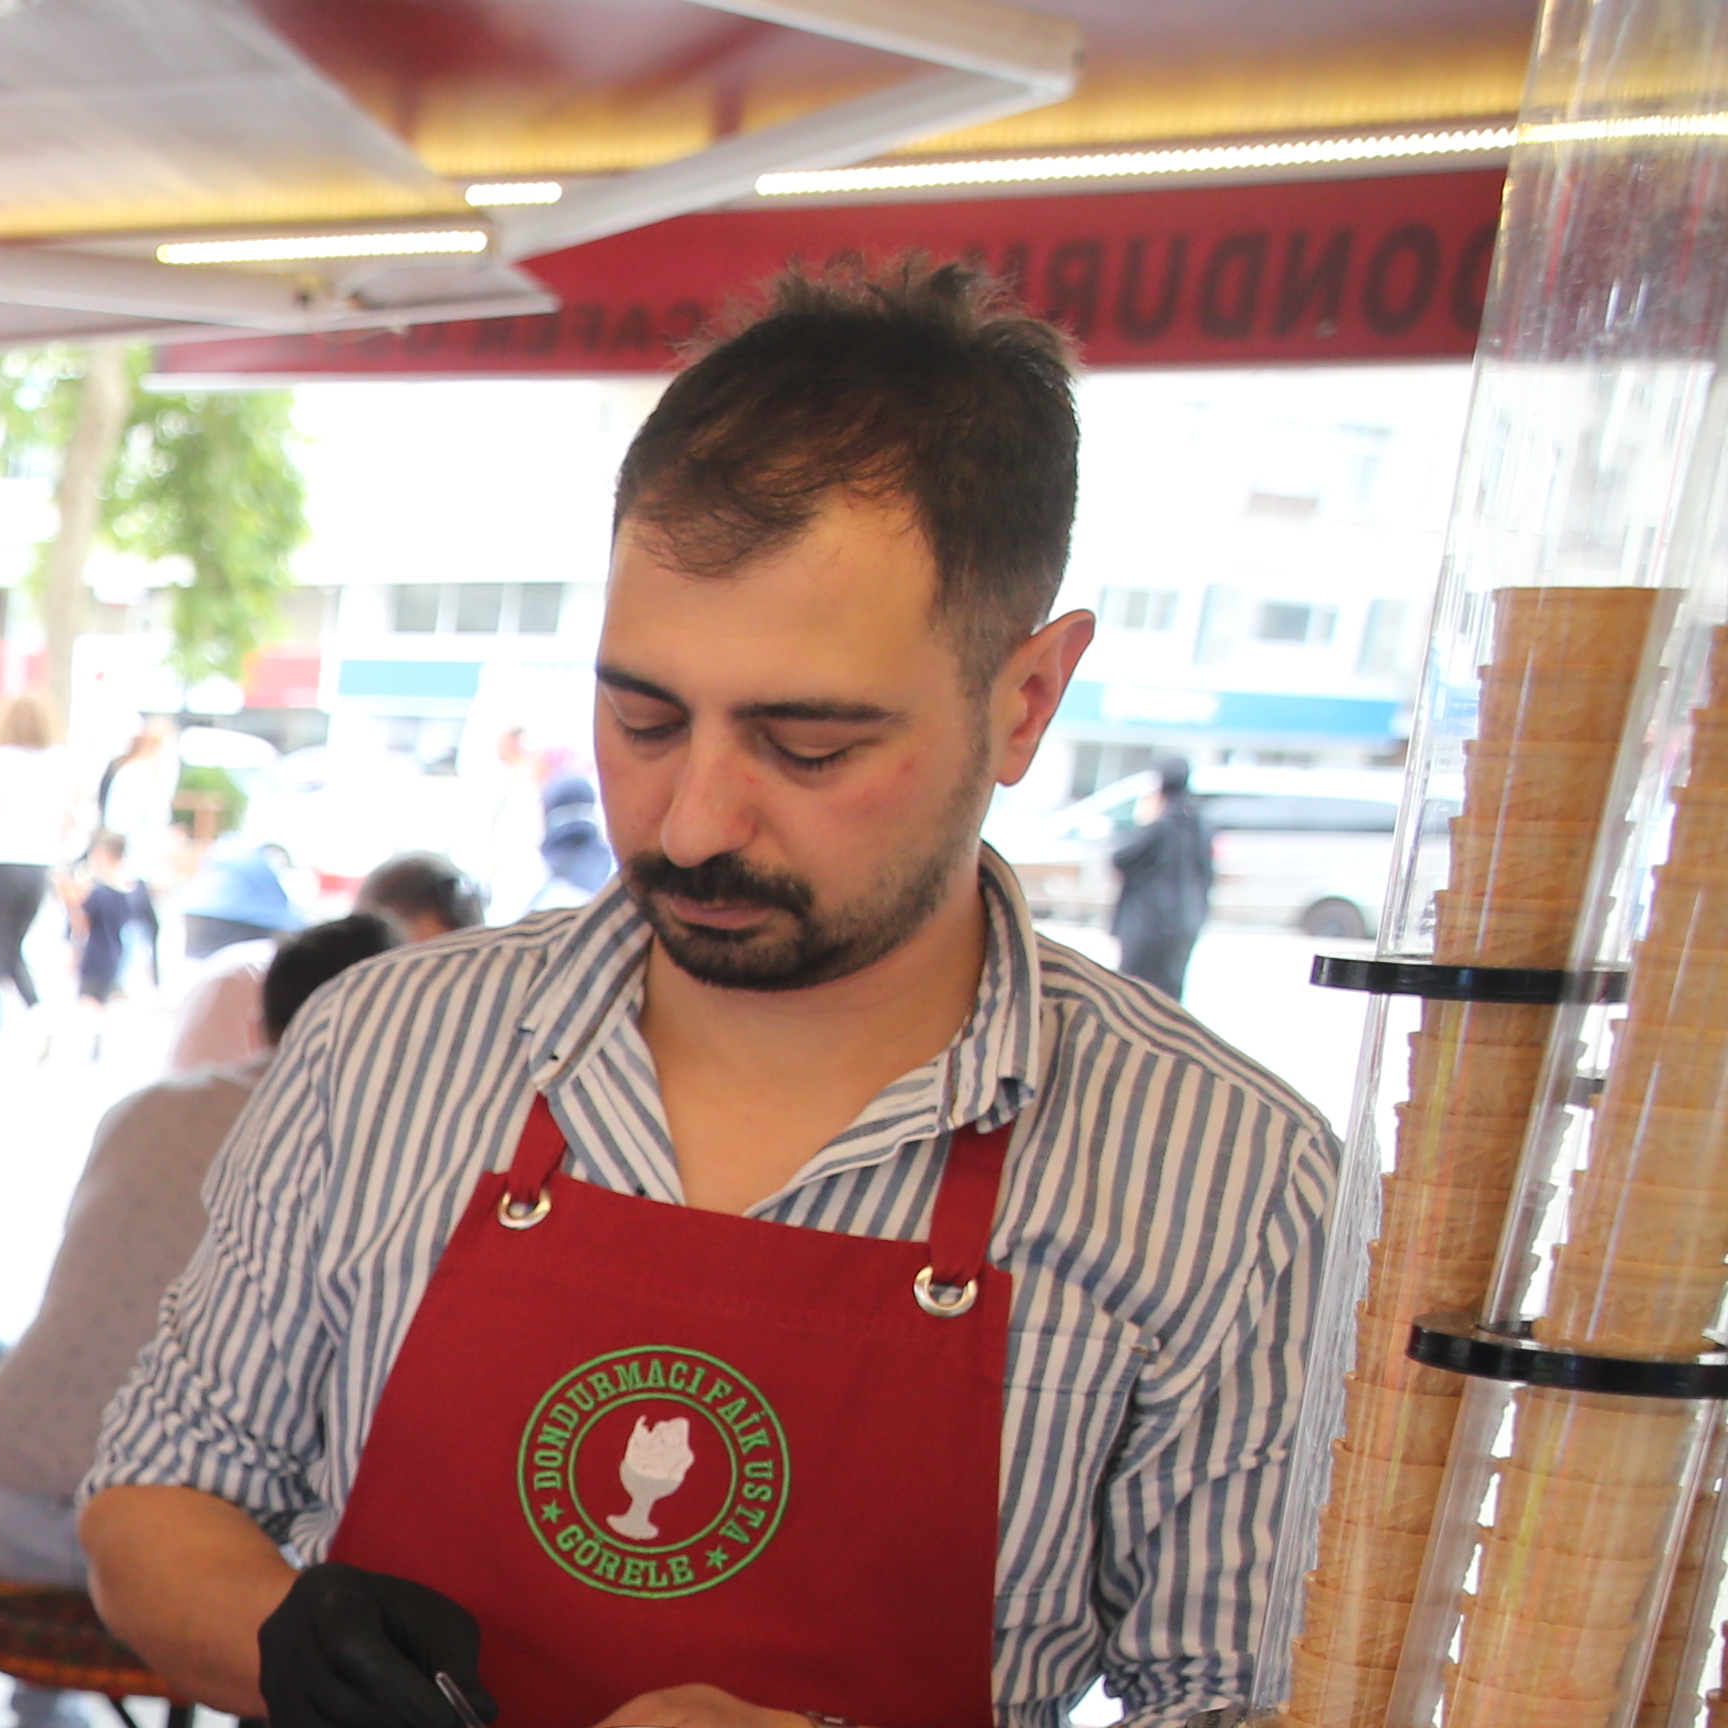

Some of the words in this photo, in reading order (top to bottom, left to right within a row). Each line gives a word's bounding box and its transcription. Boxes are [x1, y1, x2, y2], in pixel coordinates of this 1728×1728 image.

[533, 1359, 706, 1490] DONDURMACI
[703, 1378, 771, 1455] FAİK
[718, 1460, 774, 1544] USTA
[556, 1524, 694, 1587] GÖRELE
